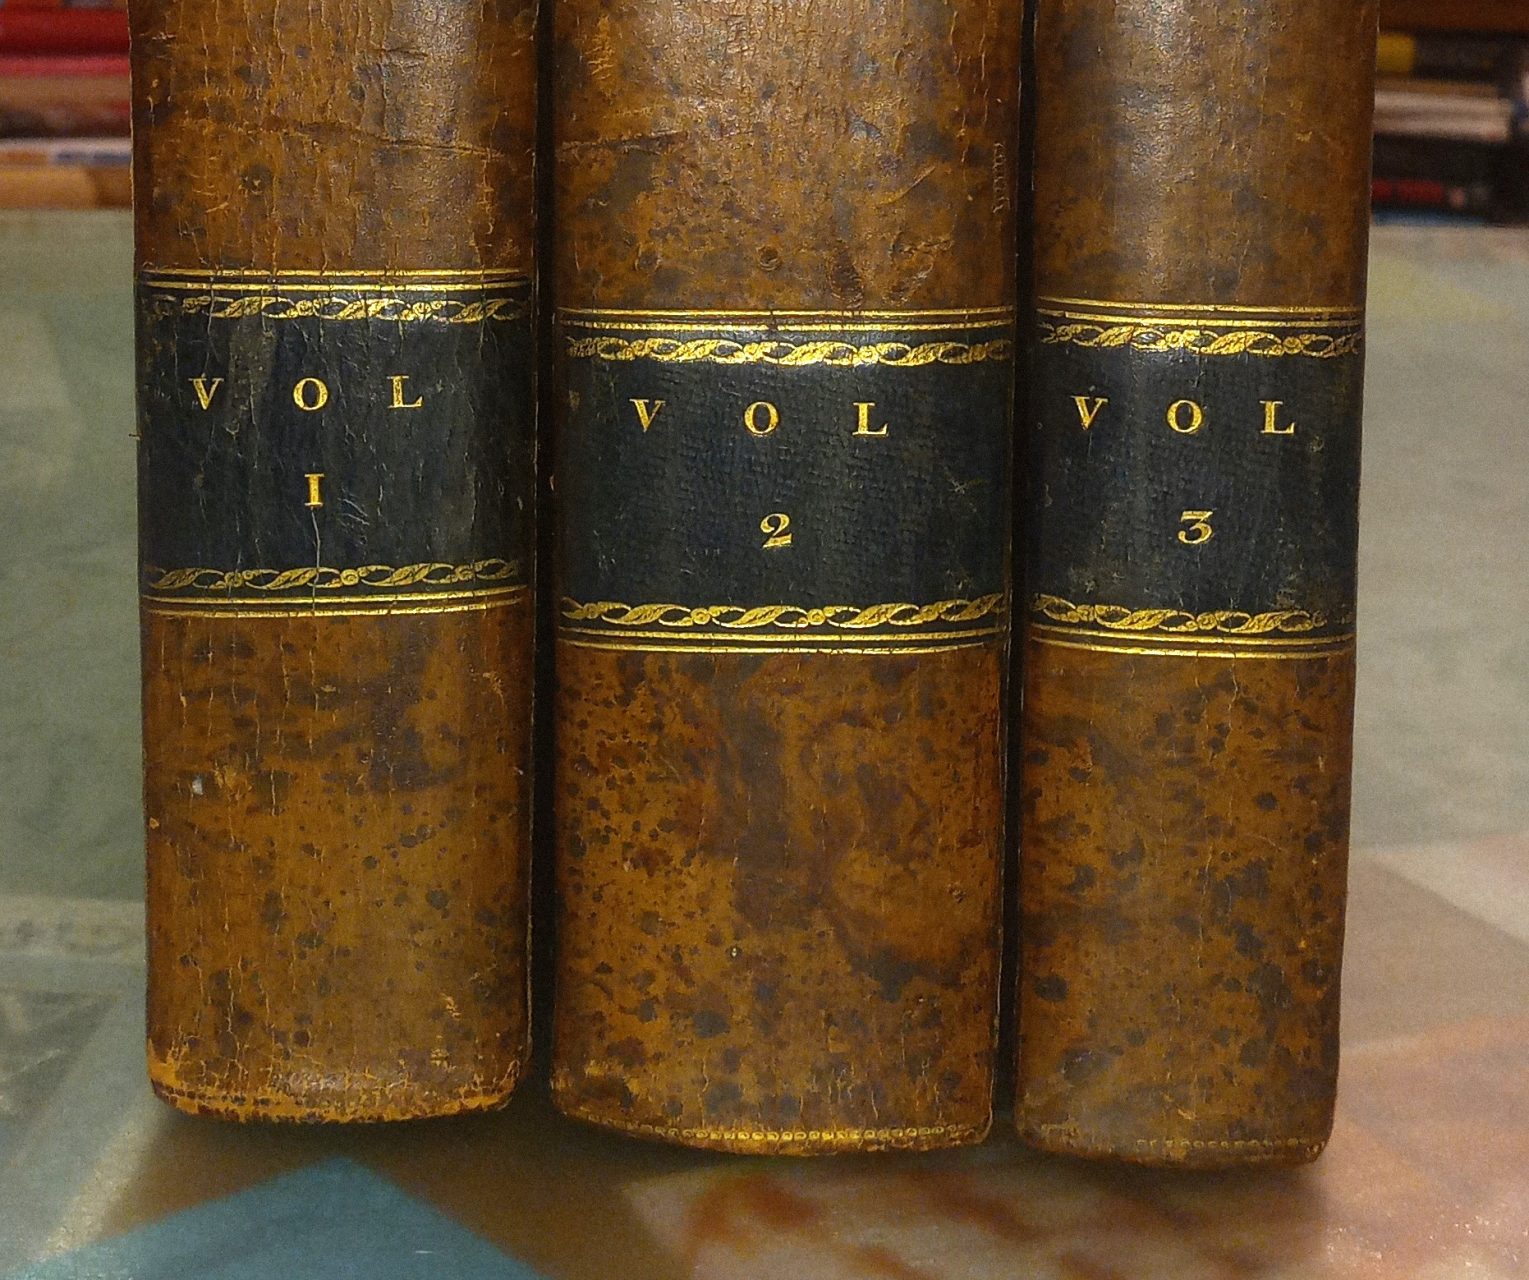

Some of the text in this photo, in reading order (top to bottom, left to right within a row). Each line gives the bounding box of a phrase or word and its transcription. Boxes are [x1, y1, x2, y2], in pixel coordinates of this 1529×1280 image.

[188, 374, 424, 411] VOL
[629, 399, 889, 438] VOL
[1070, 396, 1296, 435] VOL
[759, 513, 794, 549] 2
[1177, 509, 1214, 545] 3
